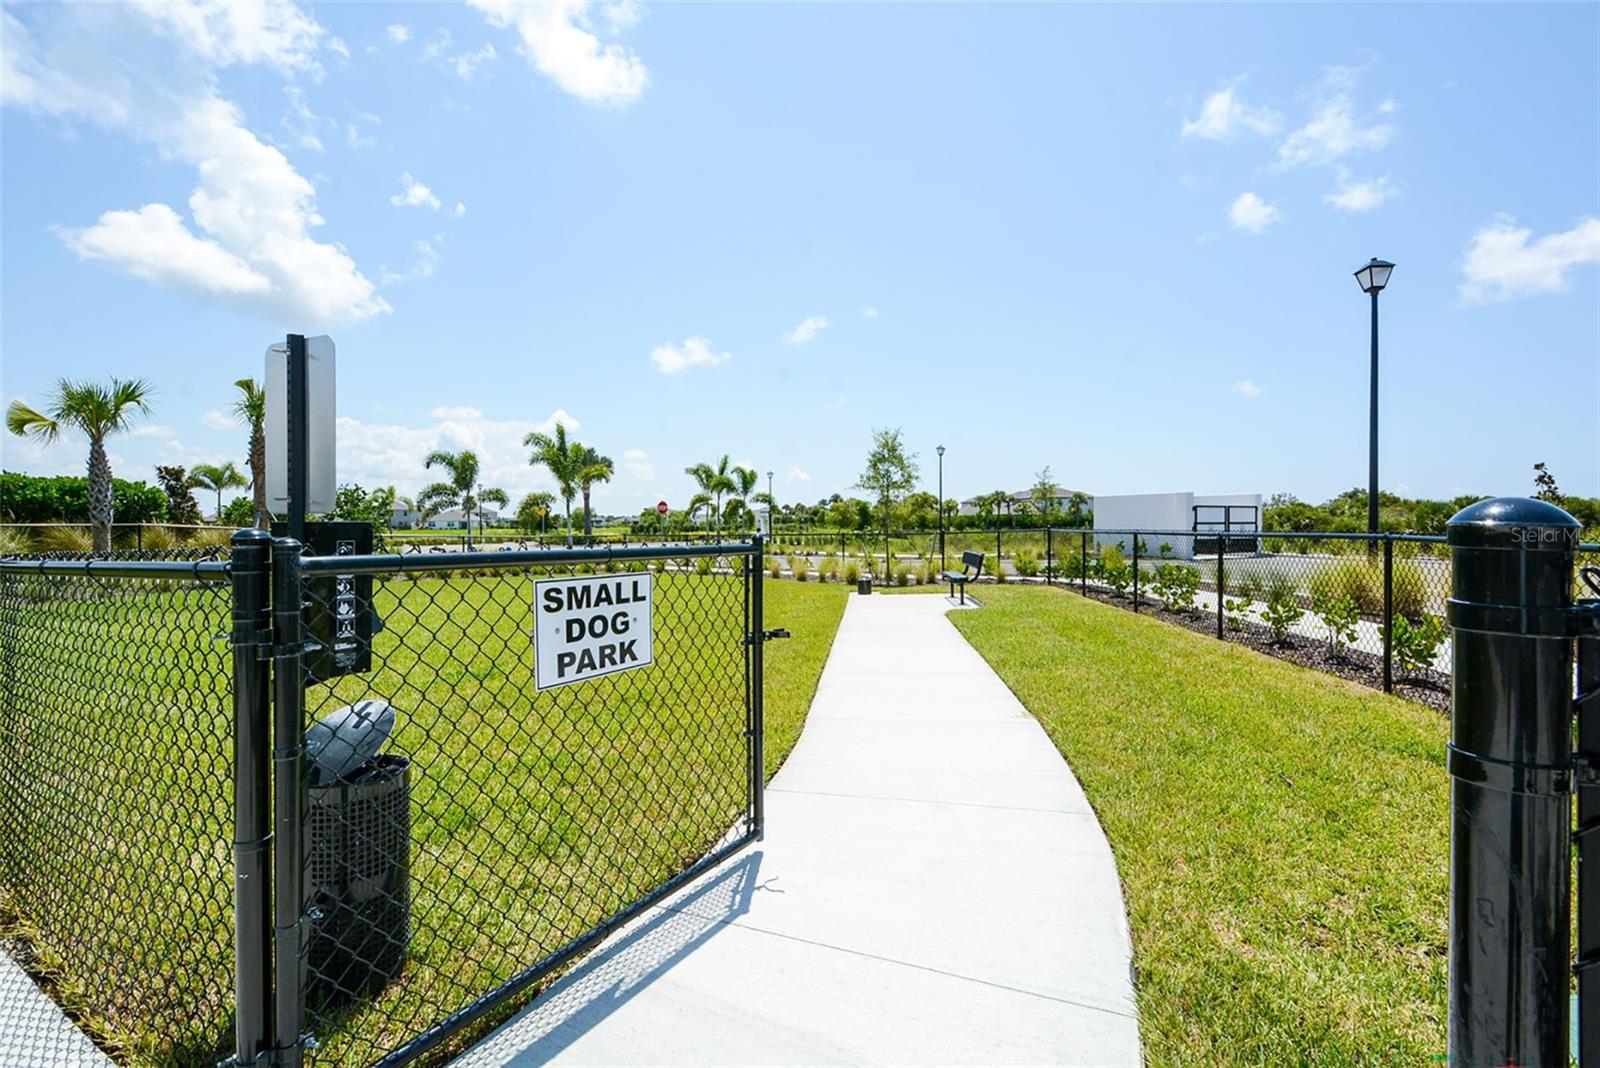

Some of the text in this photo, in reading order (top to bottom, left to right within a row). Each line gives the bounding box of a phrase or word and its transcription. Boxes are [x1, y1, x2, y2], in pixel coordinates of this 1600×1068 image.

[543, 581, 646, 613] SMALL
[566, 611, 630, 643] DOG
[557, 639, 638, 678] PARK
